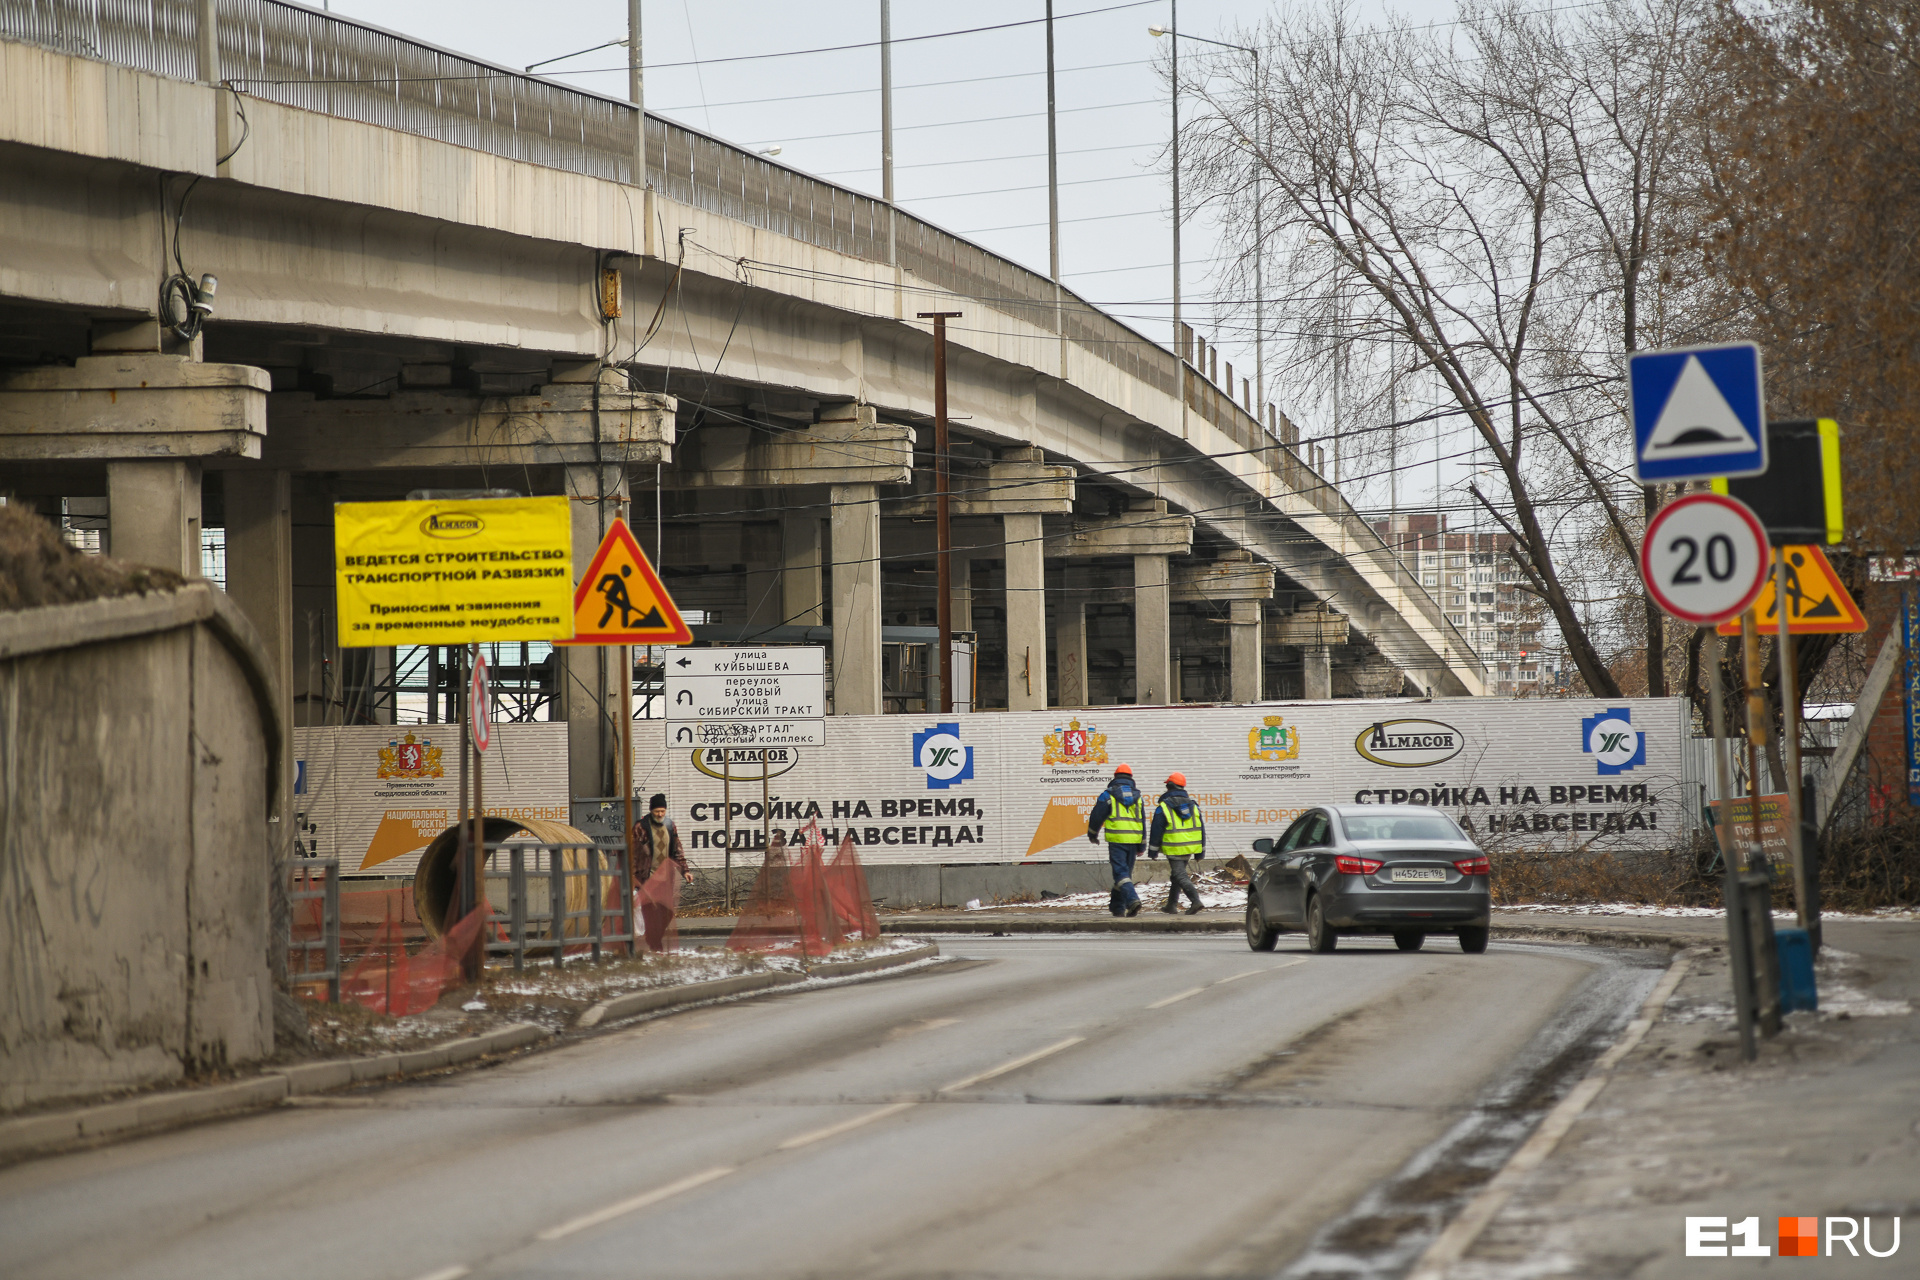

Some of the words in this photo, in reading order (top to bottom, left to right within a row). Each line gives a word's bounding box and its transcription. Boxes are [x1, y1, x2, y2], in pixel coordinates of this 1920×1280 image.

[429, 515, 478, 530] ALMACOR
[345, 553, 420, 567] ВЕДЕТСЯ
[424, 549, 564, 564] СТРОИТЕЛЬСТВО
[1669, 533, 1736, 586] 20
[345, 568, 477, 584] ТРАНСПОРТНОЙ
[482, 567, 565, 580] РАЗВЯЗКИ
[370, 603, 450, 615] Приносим
[456, 600, 541, 611] извинения
[352, 621, 370, 631] за
[375, 619, 465, 632] временные
[470, 616, 560, 629] неудобства
[734, 651, 767, 662] улица
[714, 660, 789, 672] КУЙБЫШЕВА
[726, 677, 779, 687] переулок
[725, 685, 781, 697] БАЗОВЫЙ
[735, 698, 768, 708] улица
[699, 704, 769, 716] СИБИРСКИЙ
[775, 706, 812, 715] ТРАКТ
[703, 733, 754, 745] офисный
[759, 735, 814, 743] комплекс
[1370, 723, 1454, 749] ALMACOR
[1051, 768, 1100, 776] Правительство
[1263, 772, 1311, 780] Екатеринбурга
[1040, 775, 1084, 784] Свердловской
[1086, 775, 1112, 783] области
[386, 782, 435, 790] Правительство
[1355, 782, 1491, 806] СТРОЙКА
[1500, 786, 1542, 805] НА
[1053, 797, 1098, 806] НАЦИОНАЛЬ
[387, 810, 446, 820] НАЦИОНАЛЬНЫЕ
[690, 796, 823, 822] СТРОЙКА
[833, 800, 873, 818] НА
[881, 797, 984, 820] ВРЕМЯ,
[412, 819, 446, 828] ПРОЕКТЫ
[1489, 811, 1658, 834] НАВСЕГДА!
[691, 828, 806, 848] ПОЛЬЗА
[822, 825, 984, 847] НАВСЕГДА!
[1734, 838, 1786, 849] Покаска
[1394, 869, 1429, 879] Н452ЕЕ
[1430, 869, 1444, 877] 196
